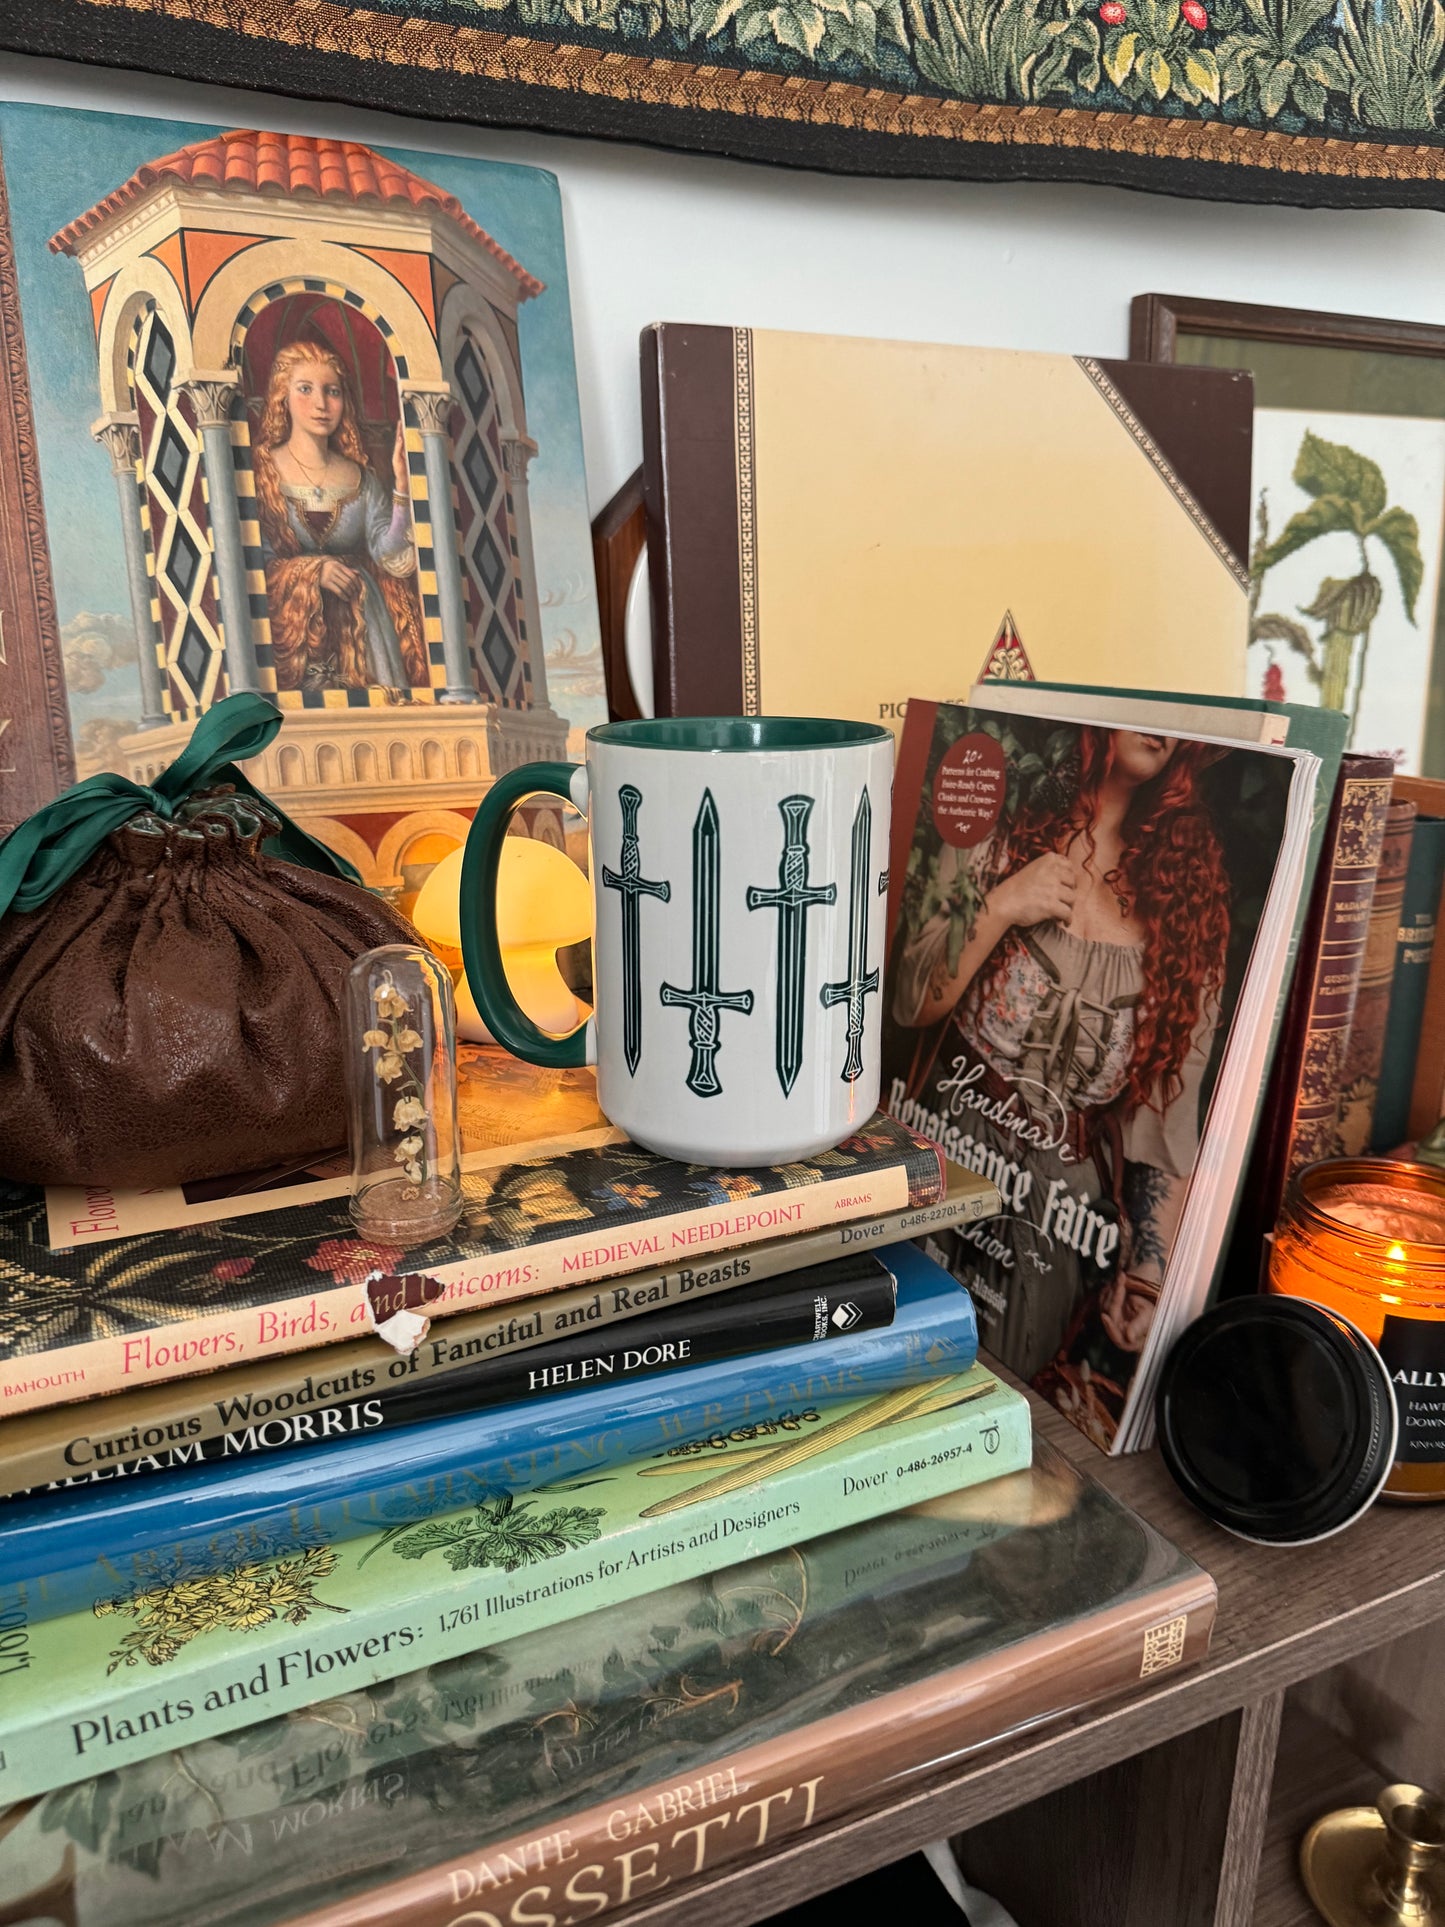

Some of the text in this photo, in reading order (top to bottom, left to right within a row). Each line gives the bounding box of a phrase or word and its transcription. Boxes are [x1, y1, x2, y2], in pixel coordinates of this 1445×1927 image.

[835, 1194, 872, 1209] ABRAMS
[901, 1203, 966, 1229] 0-486-22701-4
[1040, 1178, 1119, 1269] Faire
[841, 1222, 886, 1245] Dover
[121, 1332, 244, 1375] Flowers,
[257, 1300, 337, 1345] Birds,
[562, 1236, 664, 1274] MEDIEVAL
[671, 1203, 806, 1249] NEEDLEPOINT
[4, 1369, 86, 1398] BAHOUTH
[63, 1257, 751, 1467] Curious Woodcuts of Fanciful and Real Beasts
[528, 1339, 691, 1391] HELEN DORE
[223, 1400, 384, 1456] MORRIS
[842, 1442, 973, 1498] Dover 0-486-26957-4
[70, 1499, 801, 1756] Plants and Flowers: 1,761 Illustrations for Artists and Designers
[448, 1767, 751, 1904] DANTE GABRIEL
